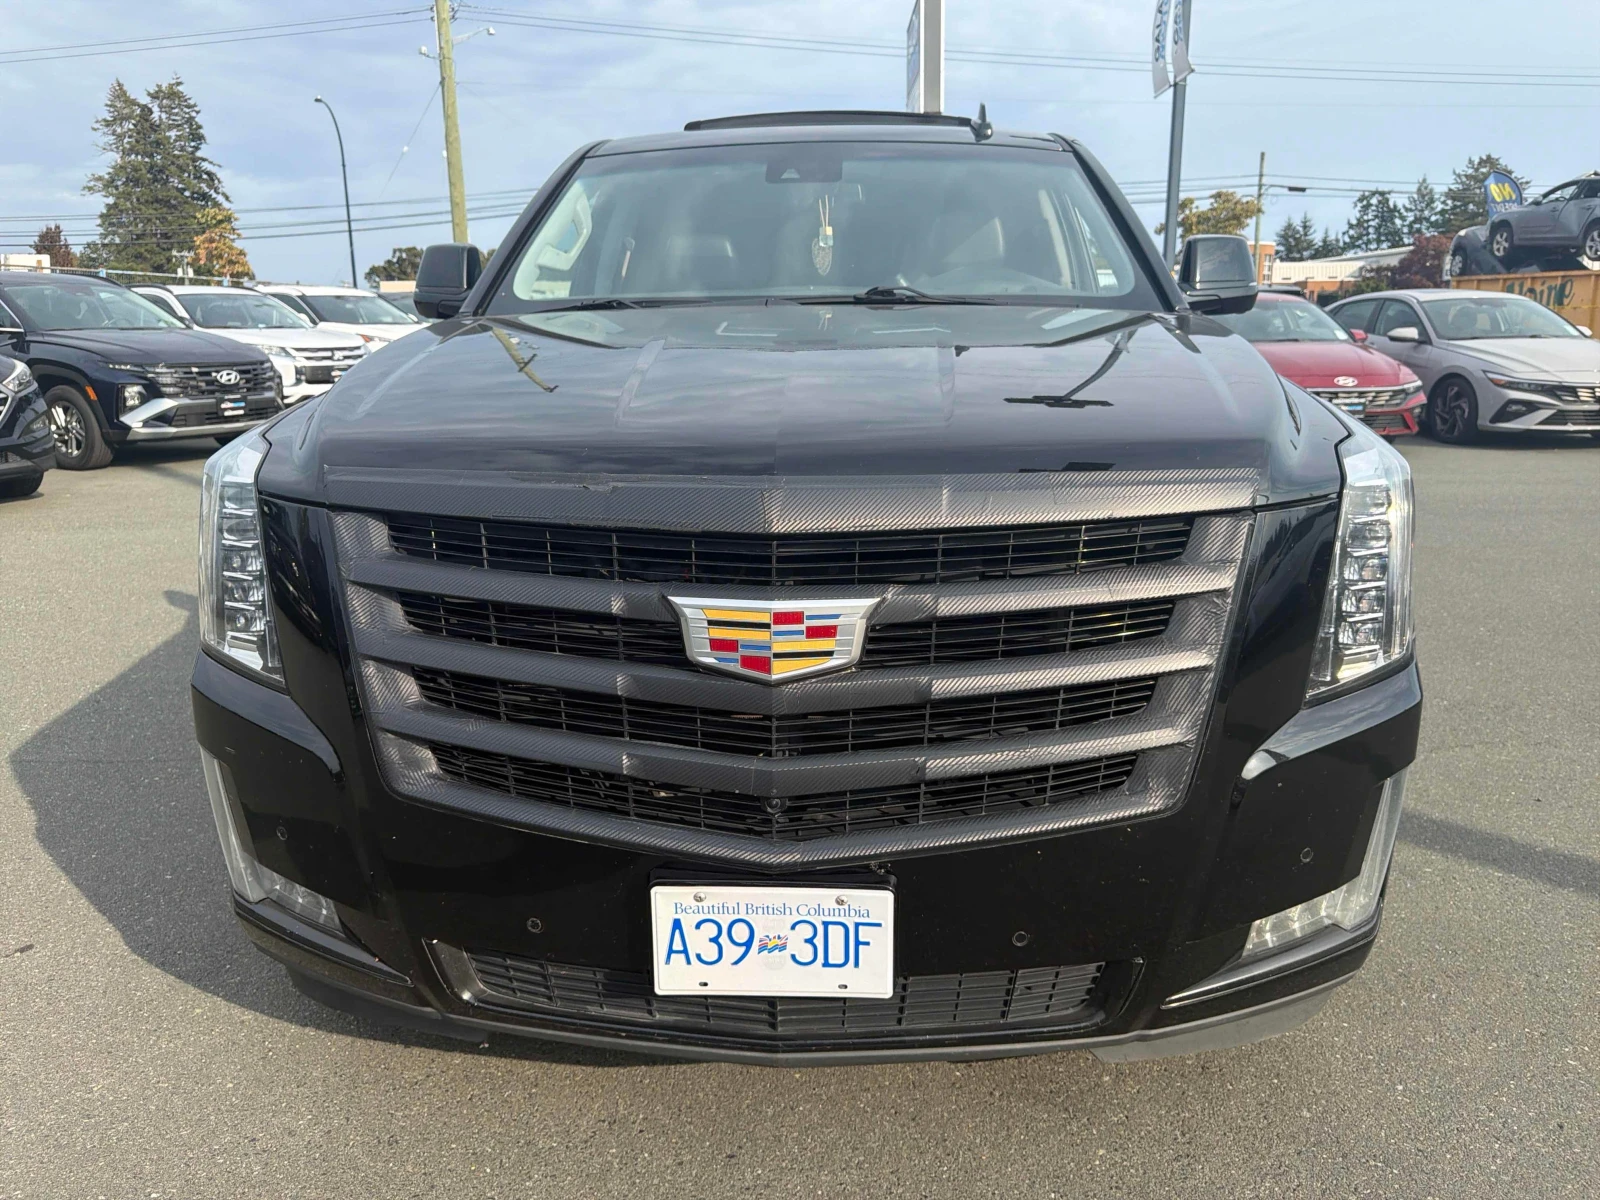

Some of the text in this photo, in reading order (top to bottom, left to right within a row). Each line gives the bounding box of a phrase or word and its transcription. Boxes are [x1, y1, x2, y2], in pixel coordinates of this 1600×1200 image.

[673, 902, 870, 918] Beautiful British Columbia
[665, 918, 882, 968] A39 3DF
